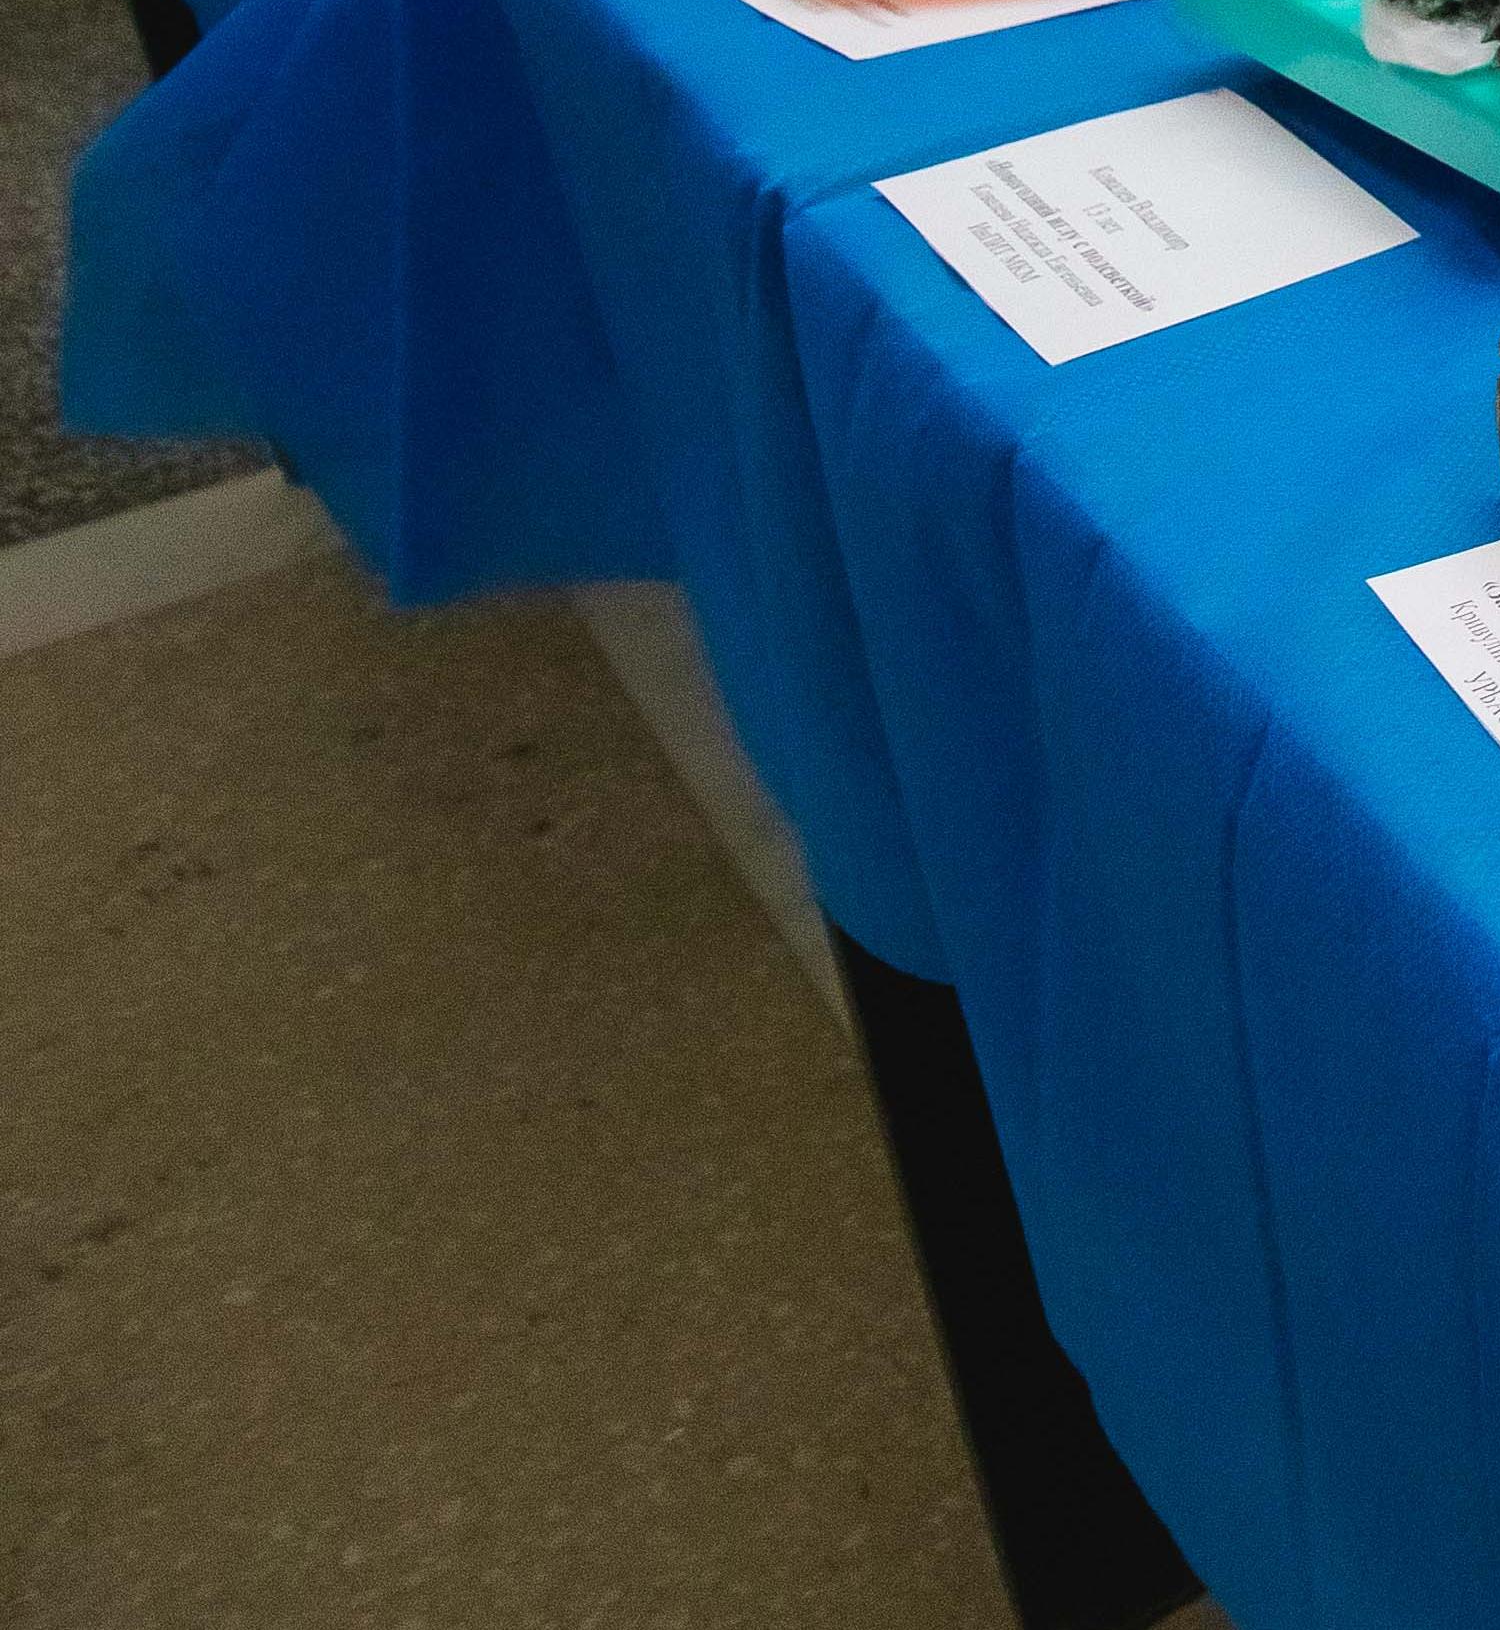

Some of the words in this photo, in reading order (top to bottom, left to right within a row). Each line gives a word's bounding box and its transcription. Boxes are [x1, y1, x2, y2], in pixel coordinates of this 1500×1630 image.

[1095, 217, 1124, 235] лет
[1072, 240, 1090, 250] с
[1080, 248, 1157, 312] подсветкой»
